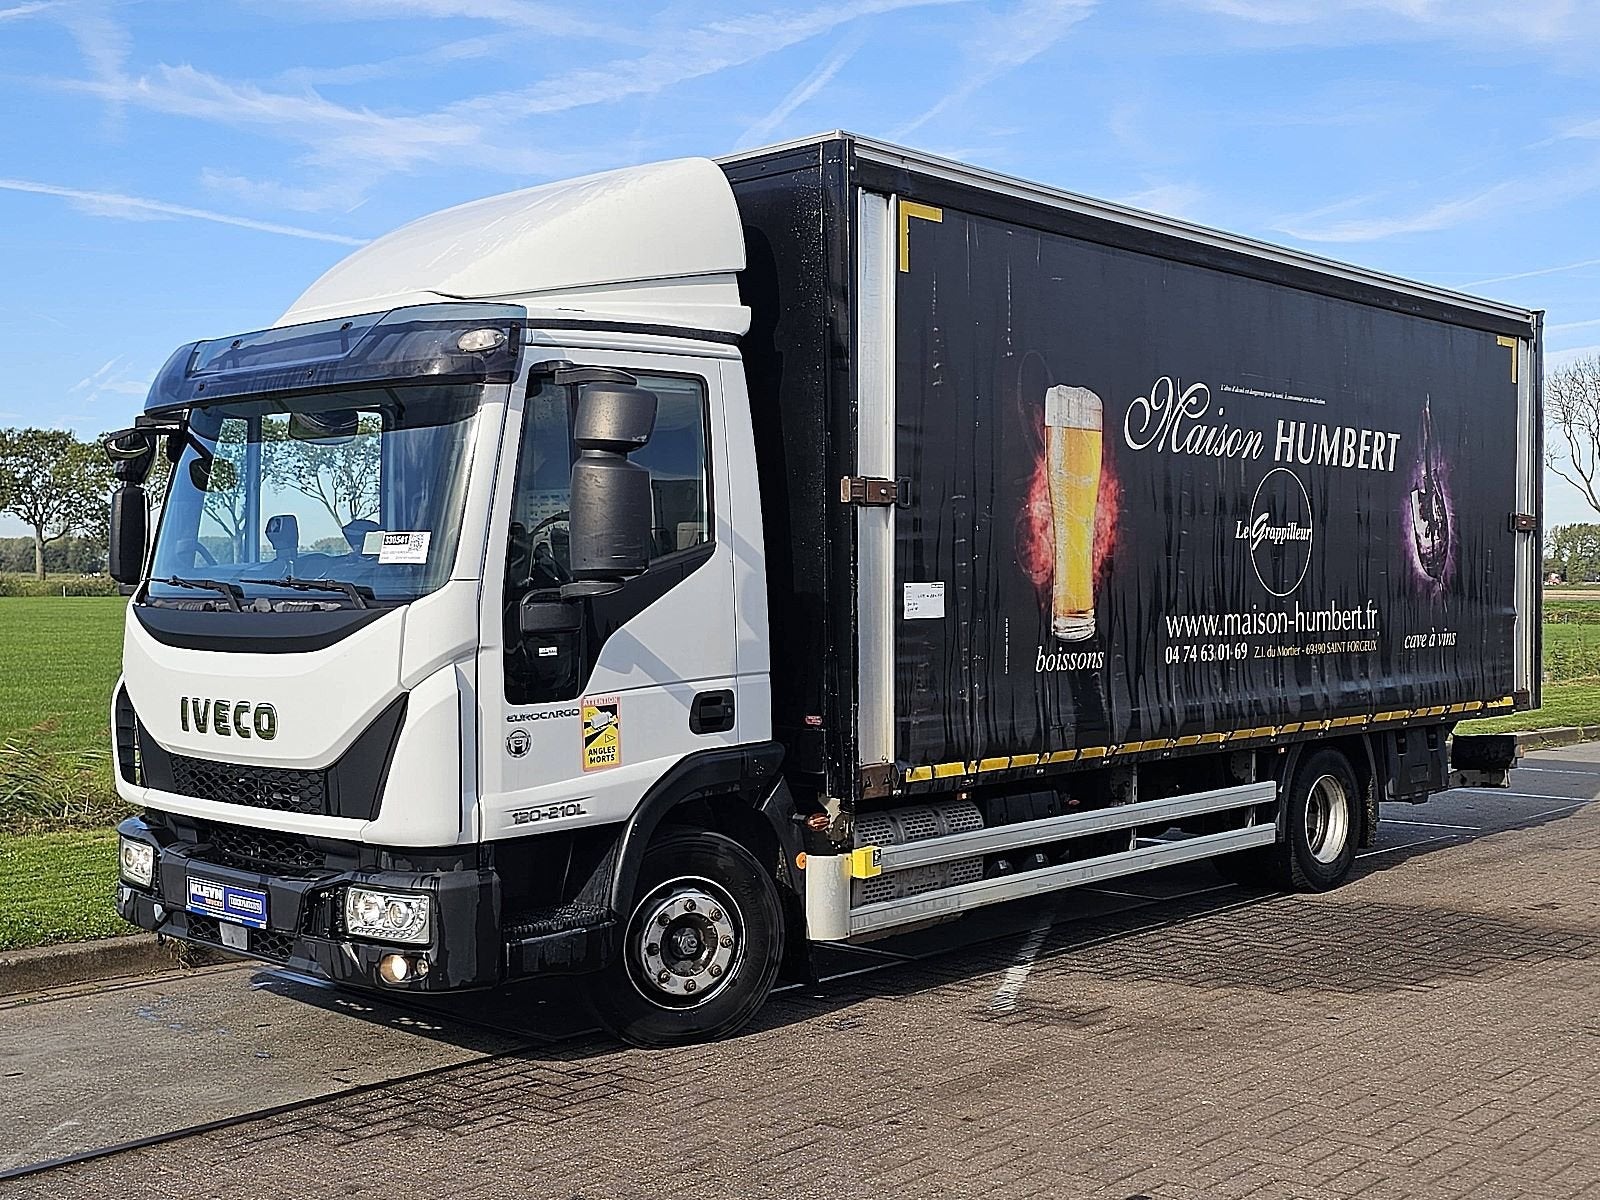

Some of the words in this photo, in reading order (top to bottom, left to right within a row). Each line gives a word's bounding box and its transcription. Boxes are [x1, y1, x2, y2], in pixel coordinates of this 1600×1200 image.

[1123, 376, 1265, 461] Maison
[1274, 418, 1401, 472] HUMBERT
[1235, 520, 1249, 539] Le
[1251, 512, 1313, 550] Grappilleur
[1165, 600, 1378, 638] www.maison-humbert.fr
[1404, 633, 1427, 649] cave
[1428, 626, 1436, 647] à
[1438, 627, 1457, 647] vins
[1035, 645, 1105, 673] boissons
[1165, 646, 1180, 664] 04
[1182, 646, 1198, 663] 74
[1233, 642, 1248, 660] 69
[1266, 644, 1276, 658] du
[1326, 641, 1346, 655] SAINT
[584, 696, 618, 706] ATTENTION
[180, 696, 279, 741] IVECO
[588, 745, 616, 757] ANGLES
[589, 754, 615, 765] MORTS
[512, 803, 587, 825] 120-210L
